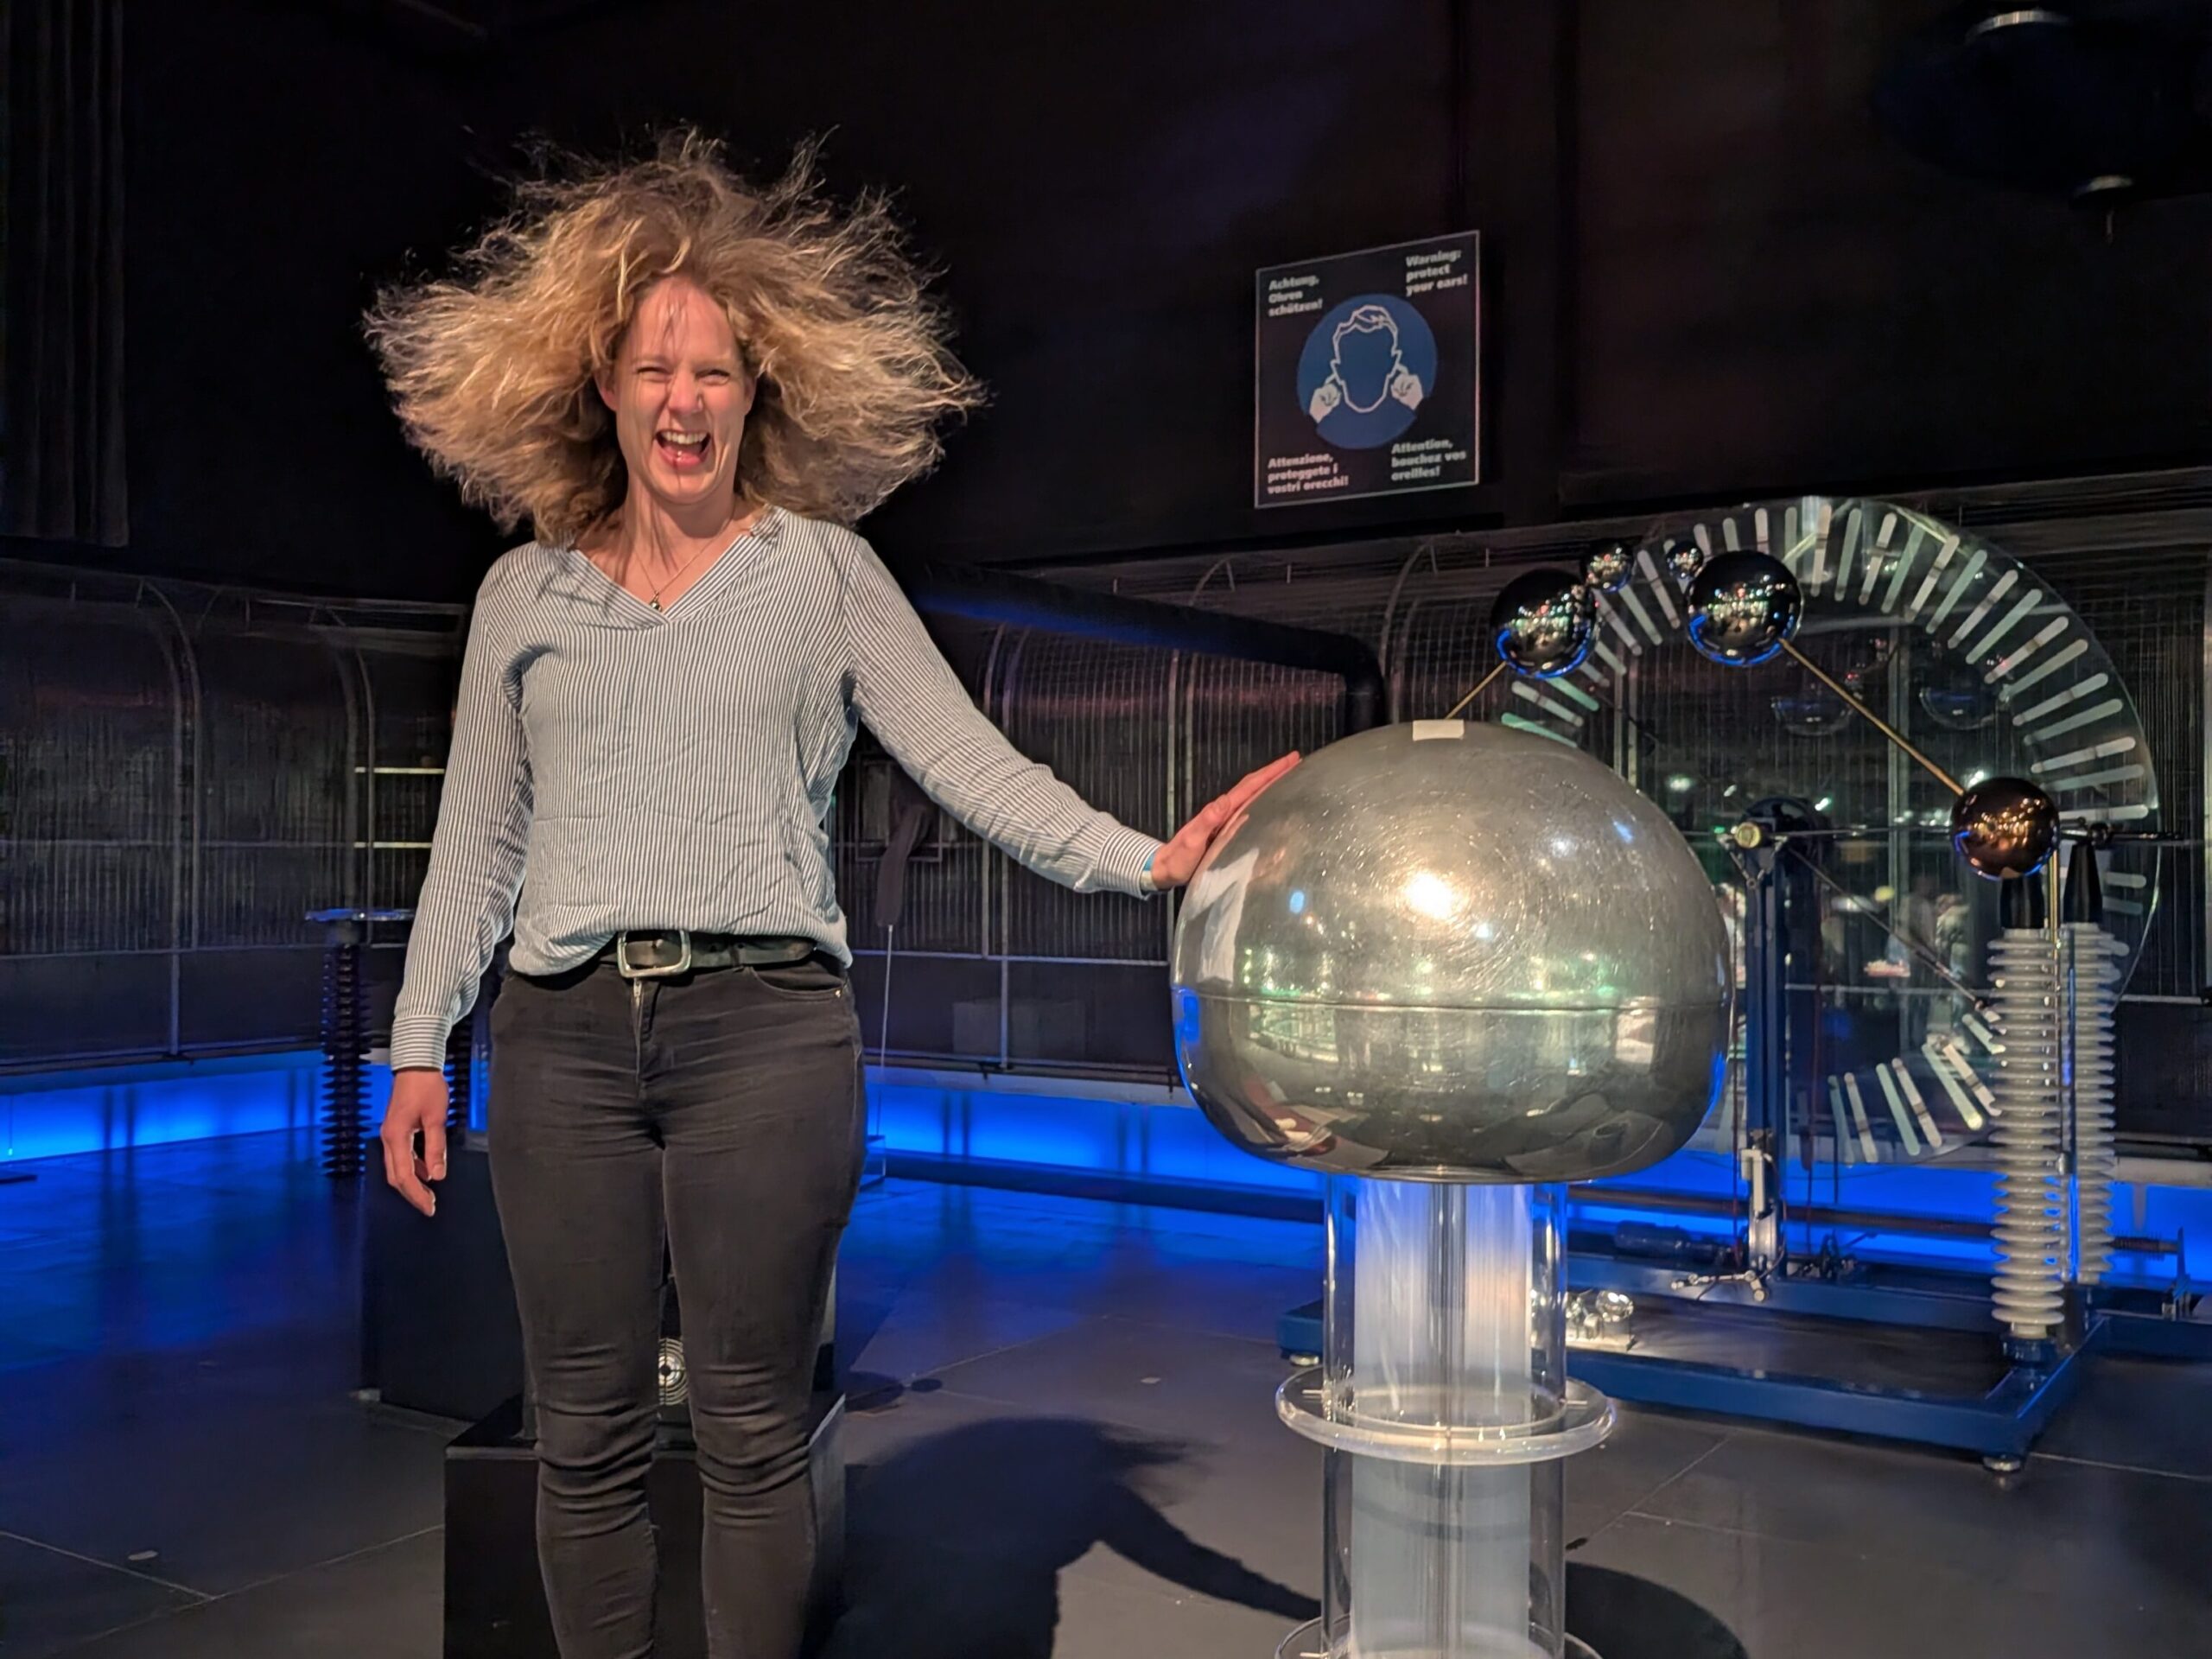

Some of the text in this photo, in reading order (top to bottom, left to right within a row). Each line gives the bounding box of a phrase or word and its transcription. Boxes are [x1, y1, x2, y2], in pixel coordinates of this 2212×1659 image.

[1406, 249, 1462, 268] Warning:
[1268, 275, 1319, 290] Achtung,
[1406, 264, 1451, 283] protect
[1406, 272, 1468, 297] your ears!
[1268, 290, 1304, 303] Ohren
[1268, 296, 1323, 317] schützen!
[1390, 438, 1453, 454] Attention,
[1268, 453, 1334, 469] Attenzione,
[1390, 449, 1467, 468] bouchez vos
[1268, 465, 1331, 484] proteggete
[1390, 465, 1441, 482] oreilles!
[1267, 474, 1349, 494] vostri orecchi!
